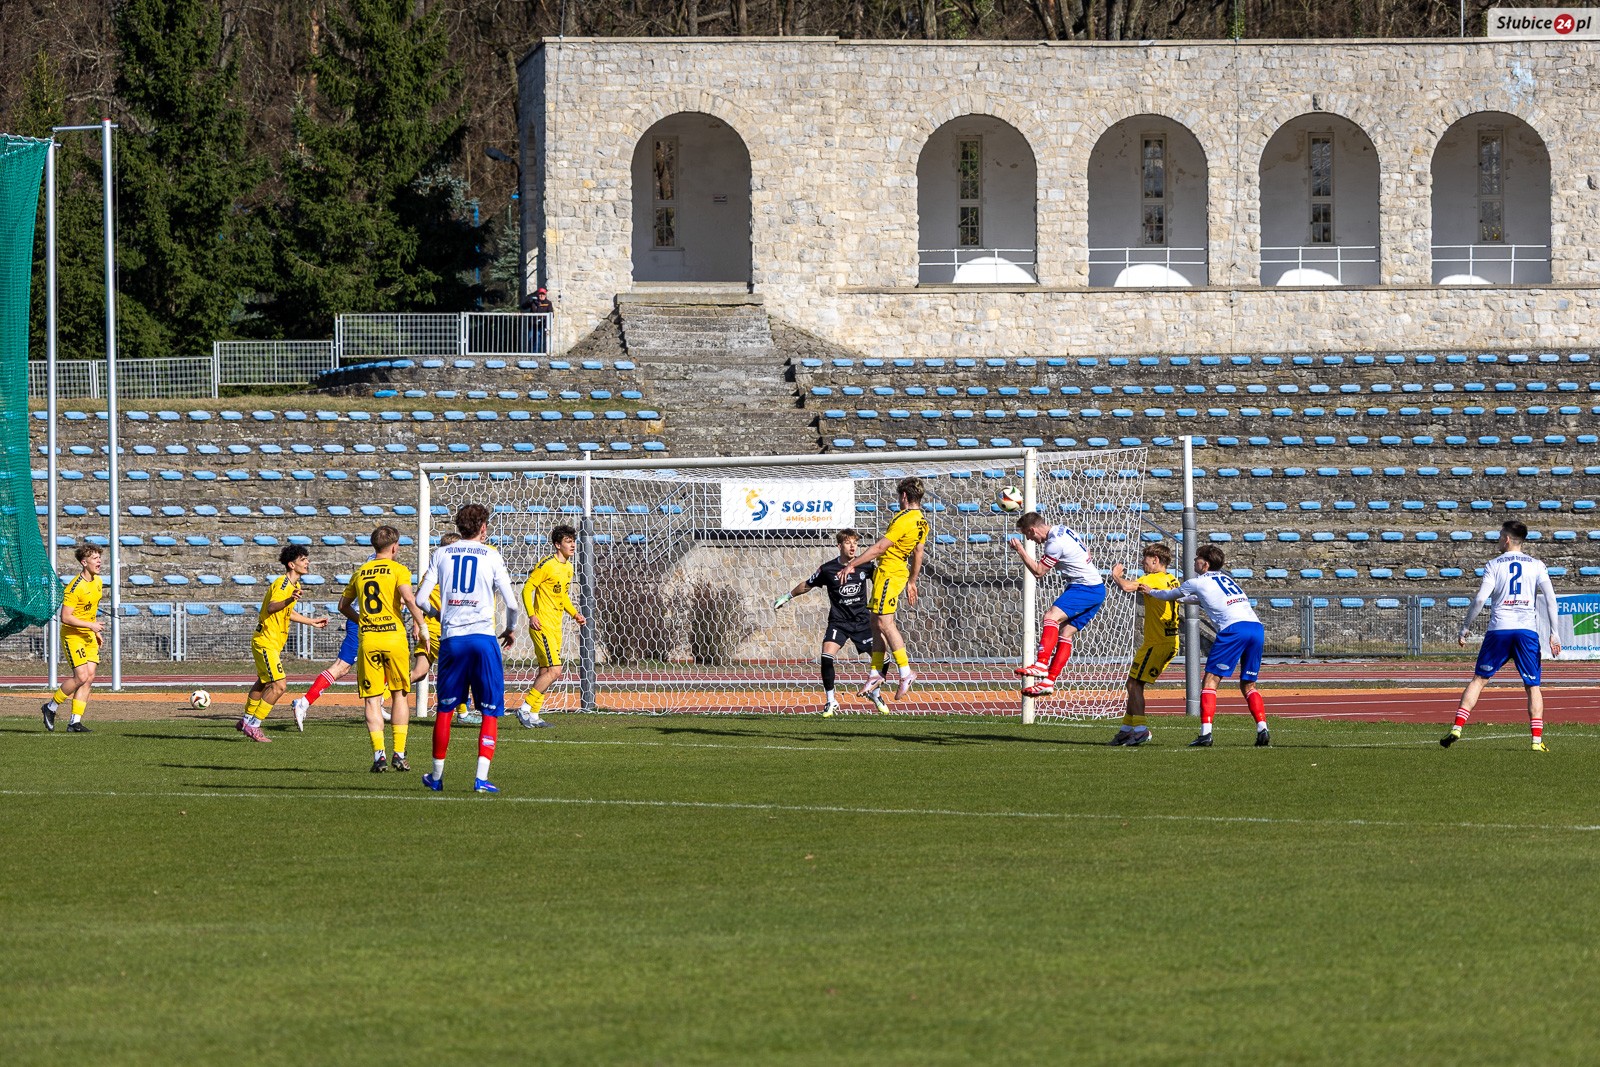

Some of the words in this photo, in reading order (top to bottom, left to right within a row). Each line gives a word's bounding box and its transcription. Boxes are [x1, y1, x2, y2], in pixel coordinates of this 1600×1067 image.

[360, 567, 391, 576] ARPOL
[451, 555, 478, 593] 10
[1509, 562, 1522, 594] 2
[1212, 576, 1243, 596] 13
[363, 580, 382, 614] 8
[1557, 602, 1600, 613] FRANKF
[832, 629, 837, 640] 1
